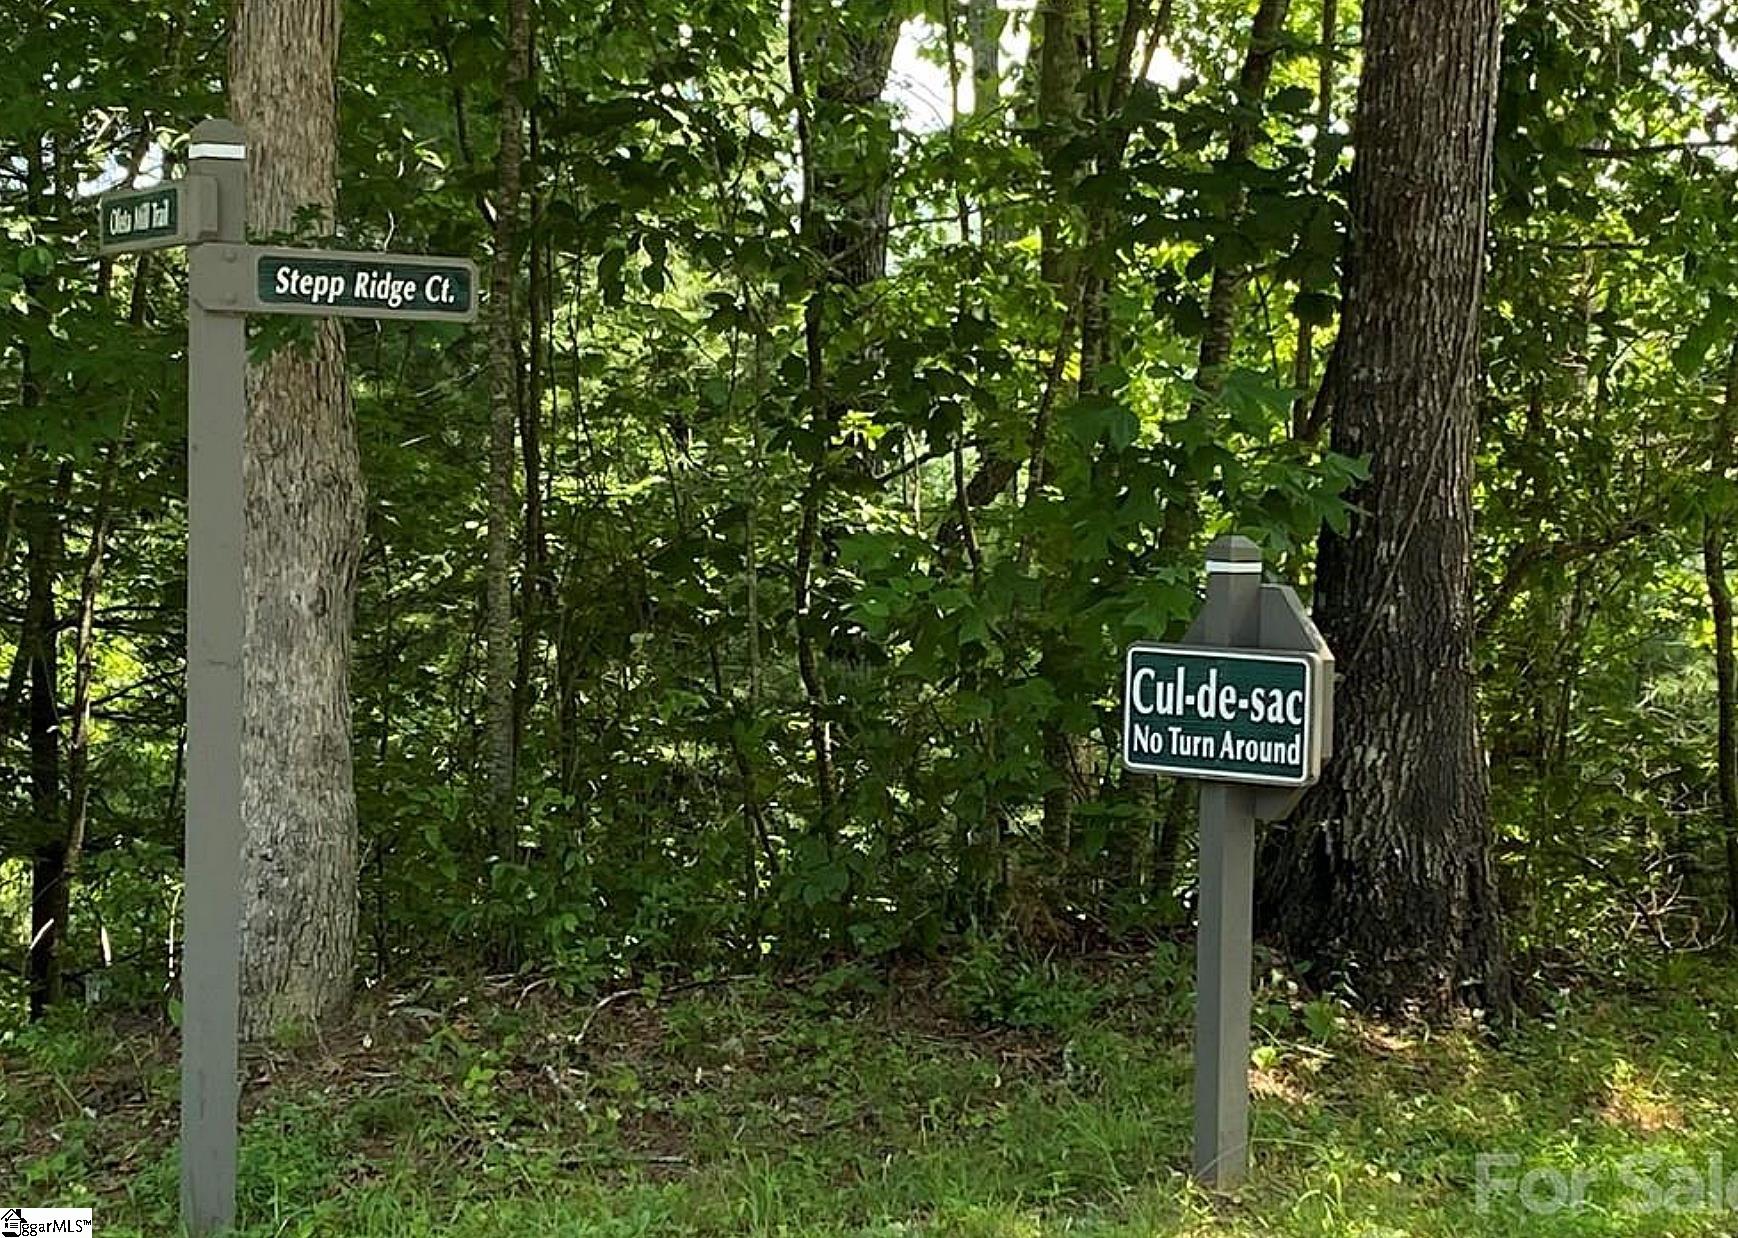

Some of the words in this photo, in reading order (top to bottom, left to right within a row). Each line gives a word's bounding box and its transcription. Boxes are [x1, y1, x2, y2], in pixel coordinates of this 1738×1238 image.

[275, 265, 345, 303] Stepp
[353, 271, 416, 308] Ridge
[425, 275, 455, 303] Ct.
[1132, 666, 1304, 726] Cul-de-sac
[1133, 723, 1163, 754] No
[1168, 726, 1215, 758] Turn
[1219, 730, 1301, 765] Around
